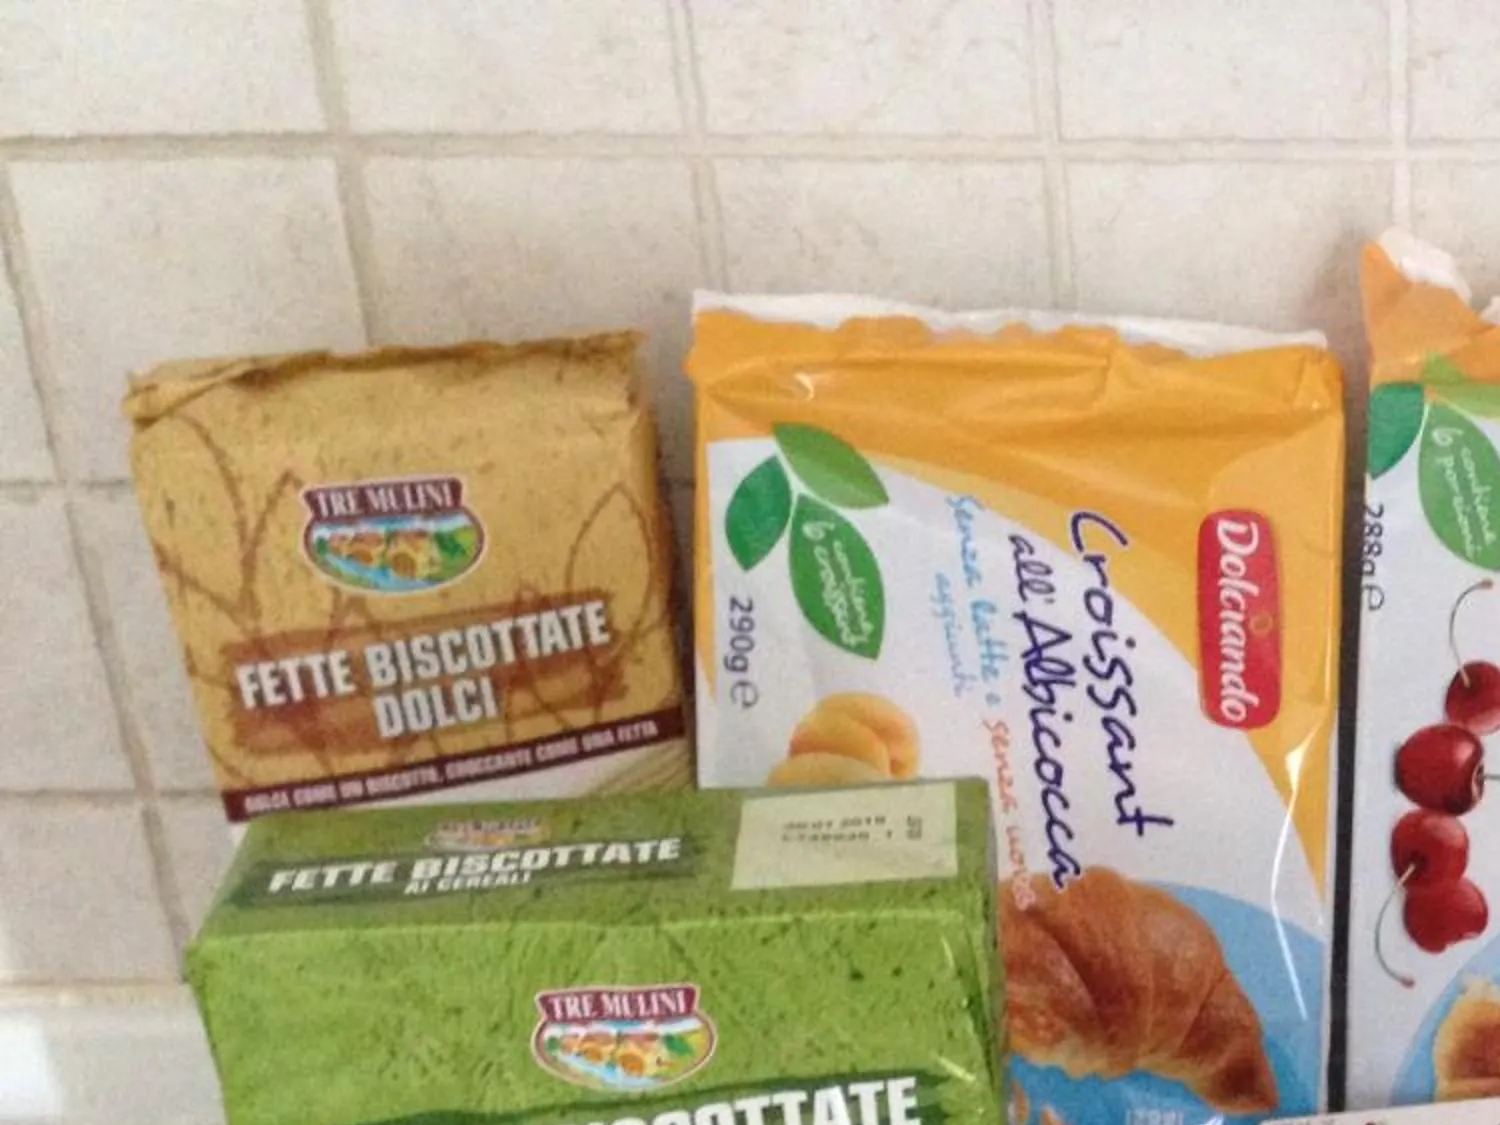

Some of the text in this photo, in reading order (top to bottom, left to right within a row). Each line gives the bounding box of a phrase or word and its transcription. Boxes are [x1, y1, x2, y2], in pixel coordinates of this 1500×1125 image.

[1432, 426, 1464, 447] 6
[316, 481, 452, 517] TRE MULINI
[802, 521, 835, 540] 6
[724, 595, 757, 675] 290g
[1217, 519, 1260, 721] Dolciando
[236, 601, 611, 709] FETTE BISCOTTATE
[1071, 511, 1174, 837] Croissant
[373, 675, 499, 740] DOLCI
[267, 836, 681, 895] FETTE BISCOTTATE
[403, 868, 532, 896] AI CEREALI
[546, 989, 689, 1020] TRE MULINI
